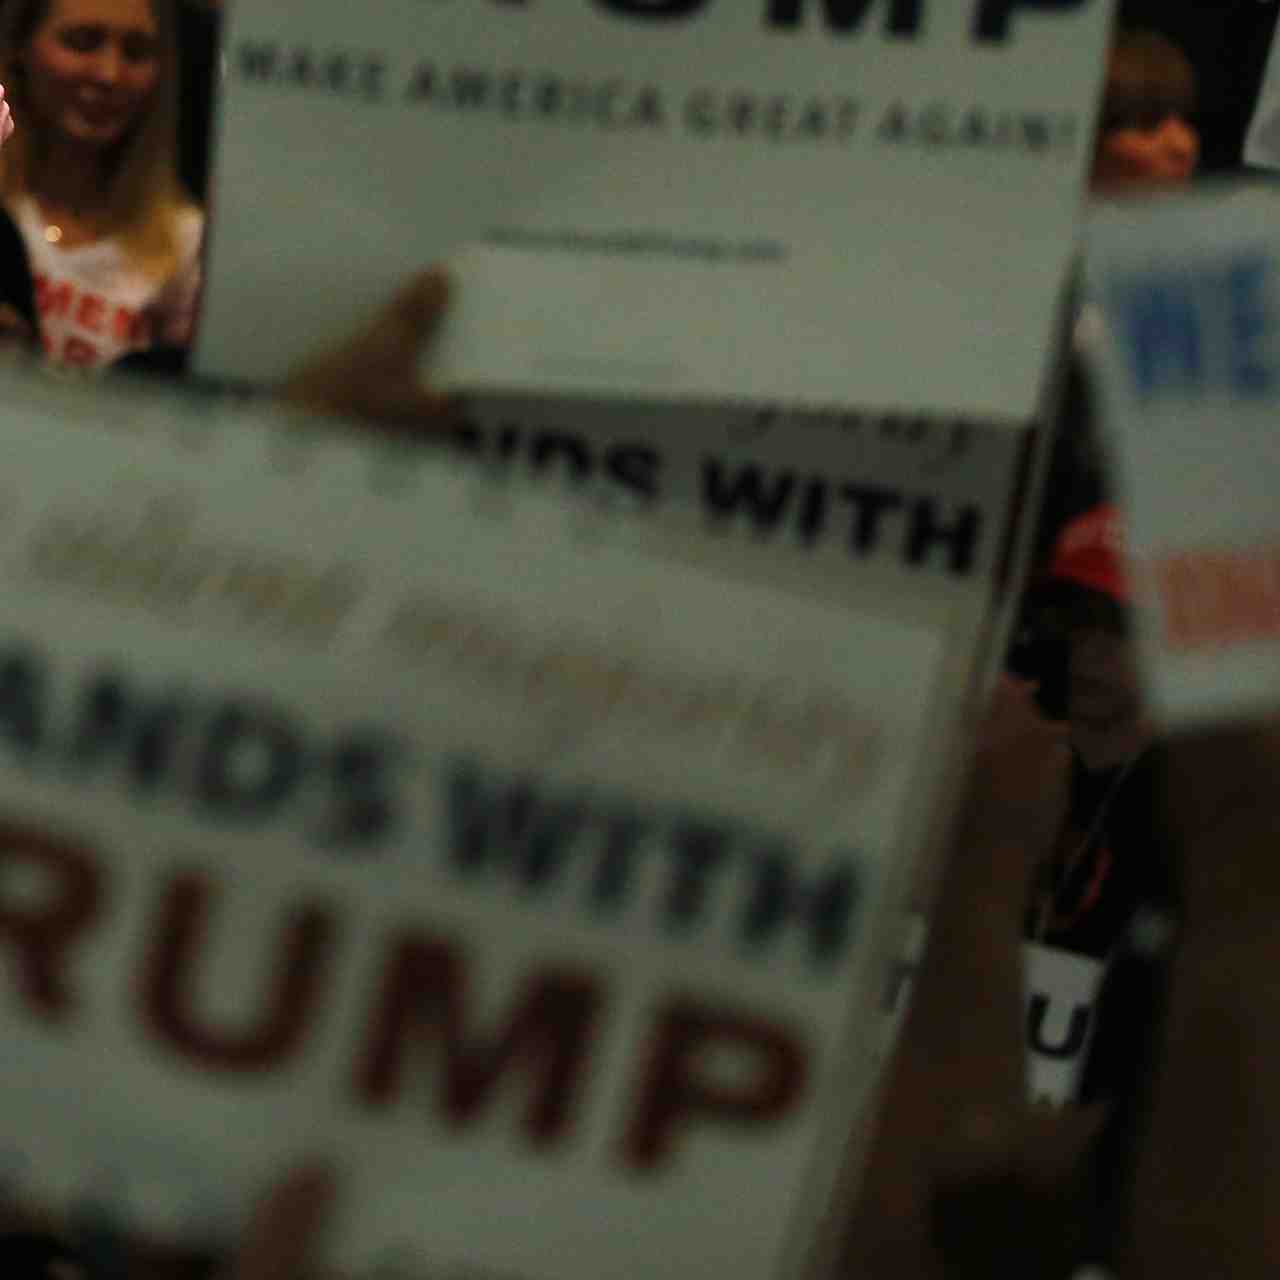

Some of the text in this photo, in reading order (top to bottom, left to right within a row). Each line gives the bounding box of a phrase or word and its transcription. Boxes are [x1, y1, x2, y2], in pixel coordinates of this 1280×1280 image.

[238, 40, 392, 102] MAKE
[404, 62, 664, 132] AMERICA
[678, 92, 862, 142] GREAT
[698, 454, 982, 576] WITH
[444, 750, 868, 972] WITH
